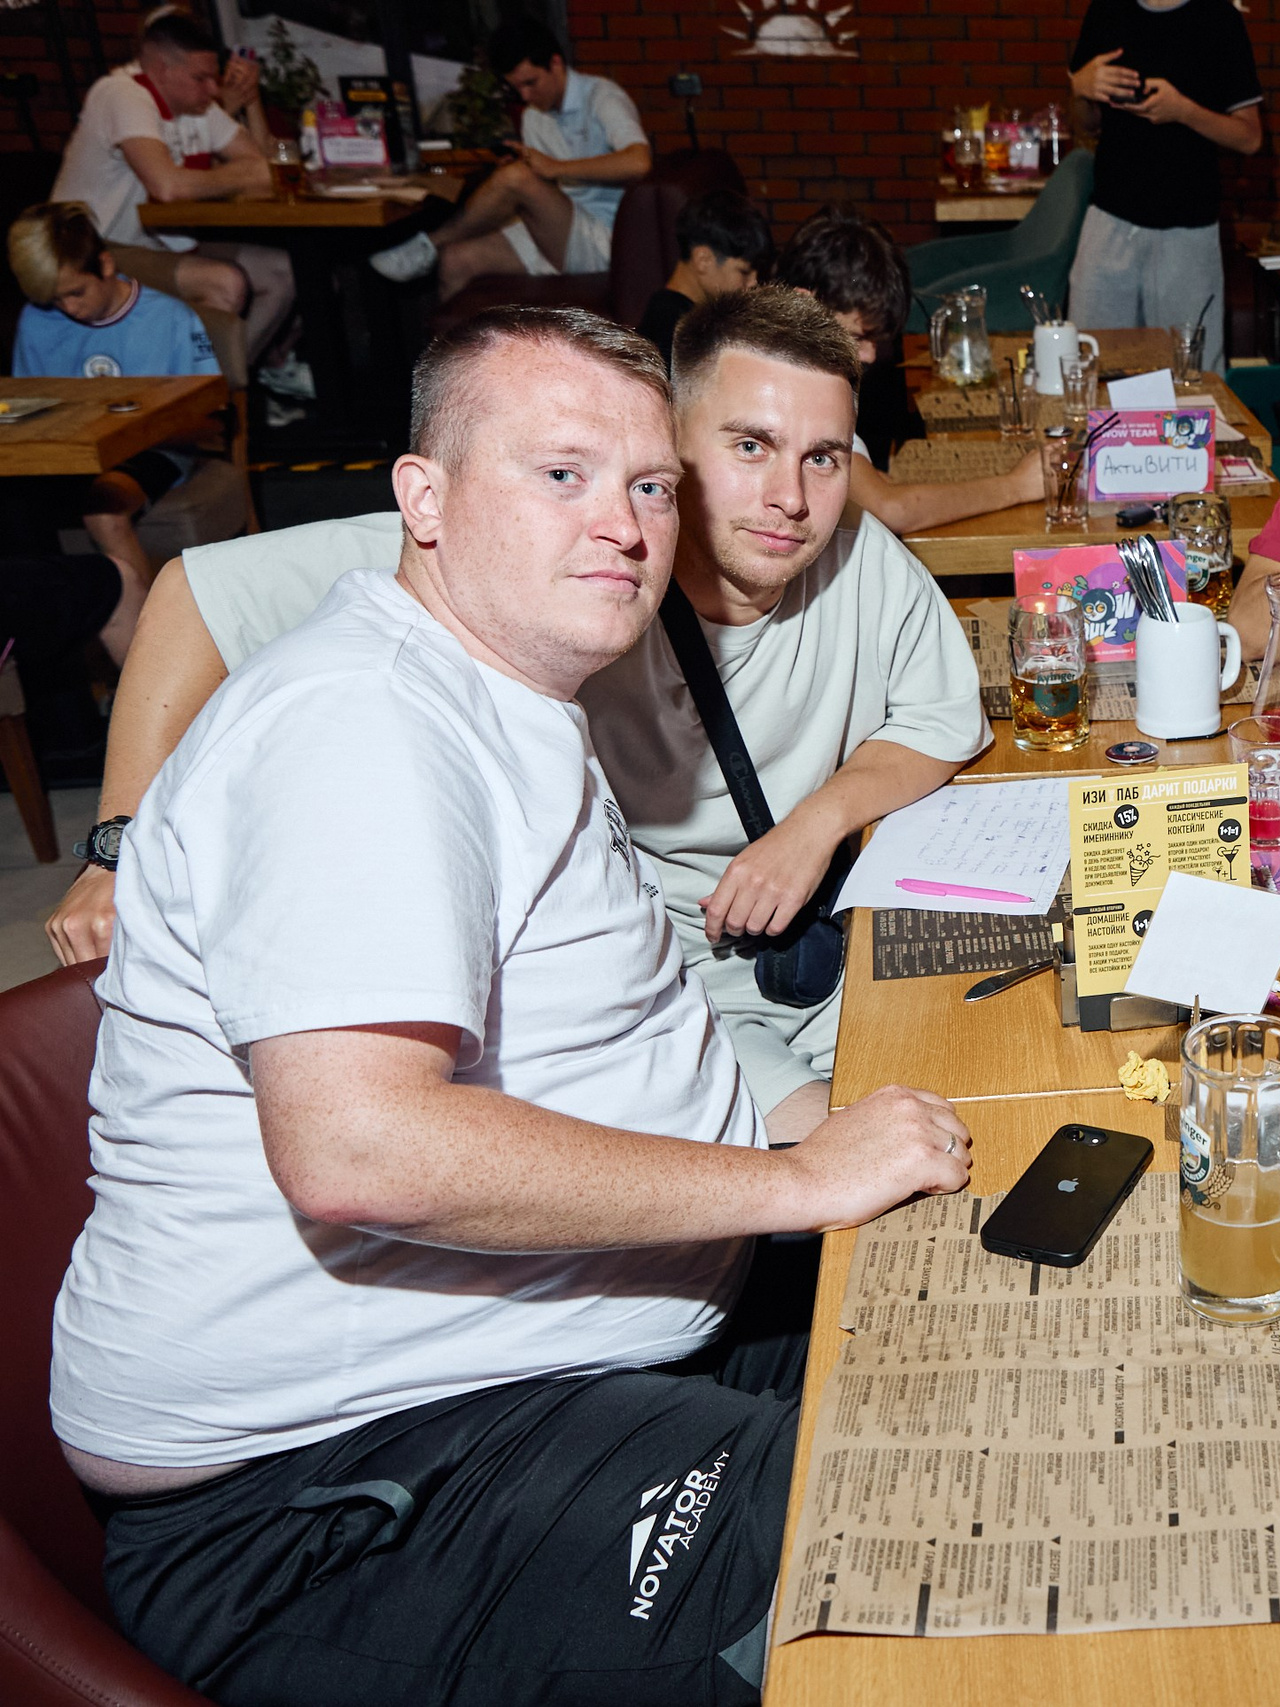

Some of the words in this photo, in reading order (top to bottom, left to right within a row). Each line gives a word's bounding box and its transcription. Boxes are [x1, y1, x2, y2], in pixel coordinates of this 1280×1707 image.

[1132, 428, 1157, 437] TEAM
[1082, 790, 1106, 804] ИЗИ
[1116, 787, 1139, 801] ПАБ
[1142, 782, 1180, 800] ДАРИТ
[1184, 777, 1237, 795] ПОДАРКИ
[1118, 808, 1138, 825] 15%
[1168, 810, 1223, 823] КЛАССИЧЕСКИЕ
[1083, 821, 1113, 832] СКИДКА
[1168, 824, 1205, 835] КОКТЕЙЛИ
[1220, 826, 1239, 836] 1+1=1
[1084, 830, 1134, 844] ИМЕНИННИКУ
[1084, 849, 1101, 857] СКИДКА
[1102, 848, 1125, 856] ДЕЙСТВУЕТ
[1172, 856, 1186, 864] АКЦИИ
[1187, 854, 1211, 862] УЧАСТВУЮТ
[1088, 864, 1106, 872] НЕДЕЛЮ
[1200, 861, 1223, 869] КАТЕГОРИИ
[1094, 870, 1128, 880] ПРЕДЪЯВЛЕНИИ
[1087, 912, 1130, 926] ДОМАШНИЕ
[1088, 925, 1126, 937] НАСТОЙКИ
[1094, 958, 1107, 966] АКЦИИ
[1108, 956, 1133, 964] УЧАСТВУЮТ
[1098, 965, 1120, 973] НАСТОЙКИ
[923, 1246, 935, 1266] ГОРЯЧИЕ
[921, 1267, 932, 1290] ЗАКУСКИ
[1114, 1375, 1125, 1400] АССОРТИ
[1114, 1402, 1125, 1430] ЗАКУСОК
[1168, 1450, 1178, 1469] НАША
[1168, 1471, 1179, 1509] КОПТИЛЬНЯ
[679, 1451, 730, 1550] ACADEMY
[630, 1470, 708, 1620] NOVATOR
[1265, 1535, 1278, 1570] РИМСКАЯ
[828, 1545, 842, 1570] СОУСЫ
[921, 1551, 936, 1582] ГАРНИРЫ
[1049, 1549, 1061, 1582] ДЕСЕРТЫ
[1268, 1571, 1280, 1595] ПИЦЦА
